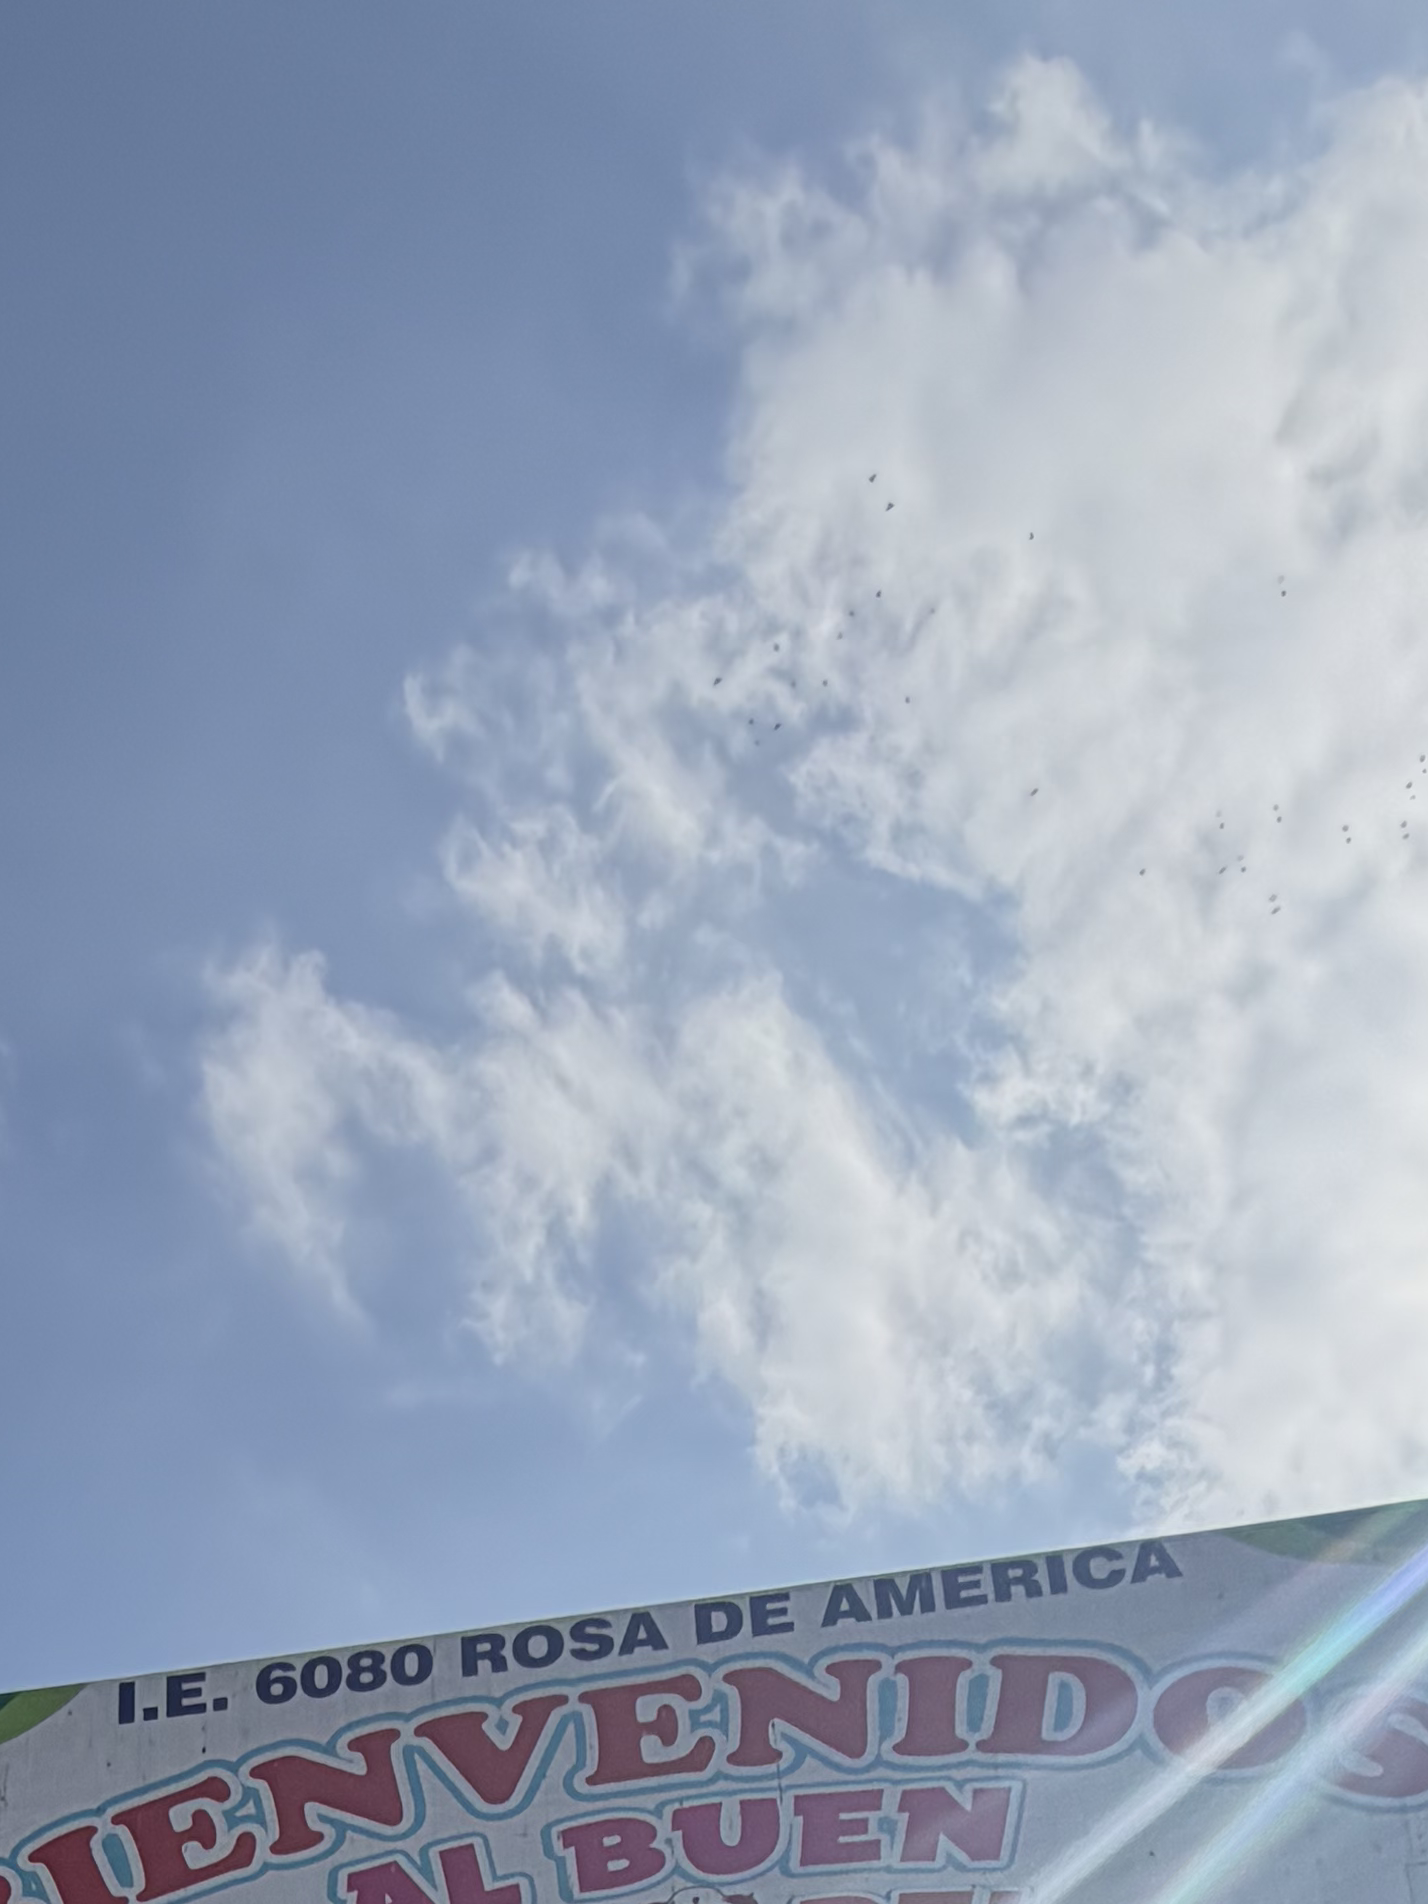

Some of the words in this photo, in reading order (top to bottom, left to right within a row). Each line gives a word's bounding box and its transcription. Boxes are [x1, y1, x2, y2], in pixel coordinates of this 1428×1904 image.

[117, 1673, 229, 1726] I.E.
[254, 1645, 434, 1707] 6080
[459, 1609, 670, 1679] ROSA
[694, 1592, 795, 1647] DE
[821, 1539, 1184, 1629] AMERICA
[559, 1785, 1017, 1895] BUEN
